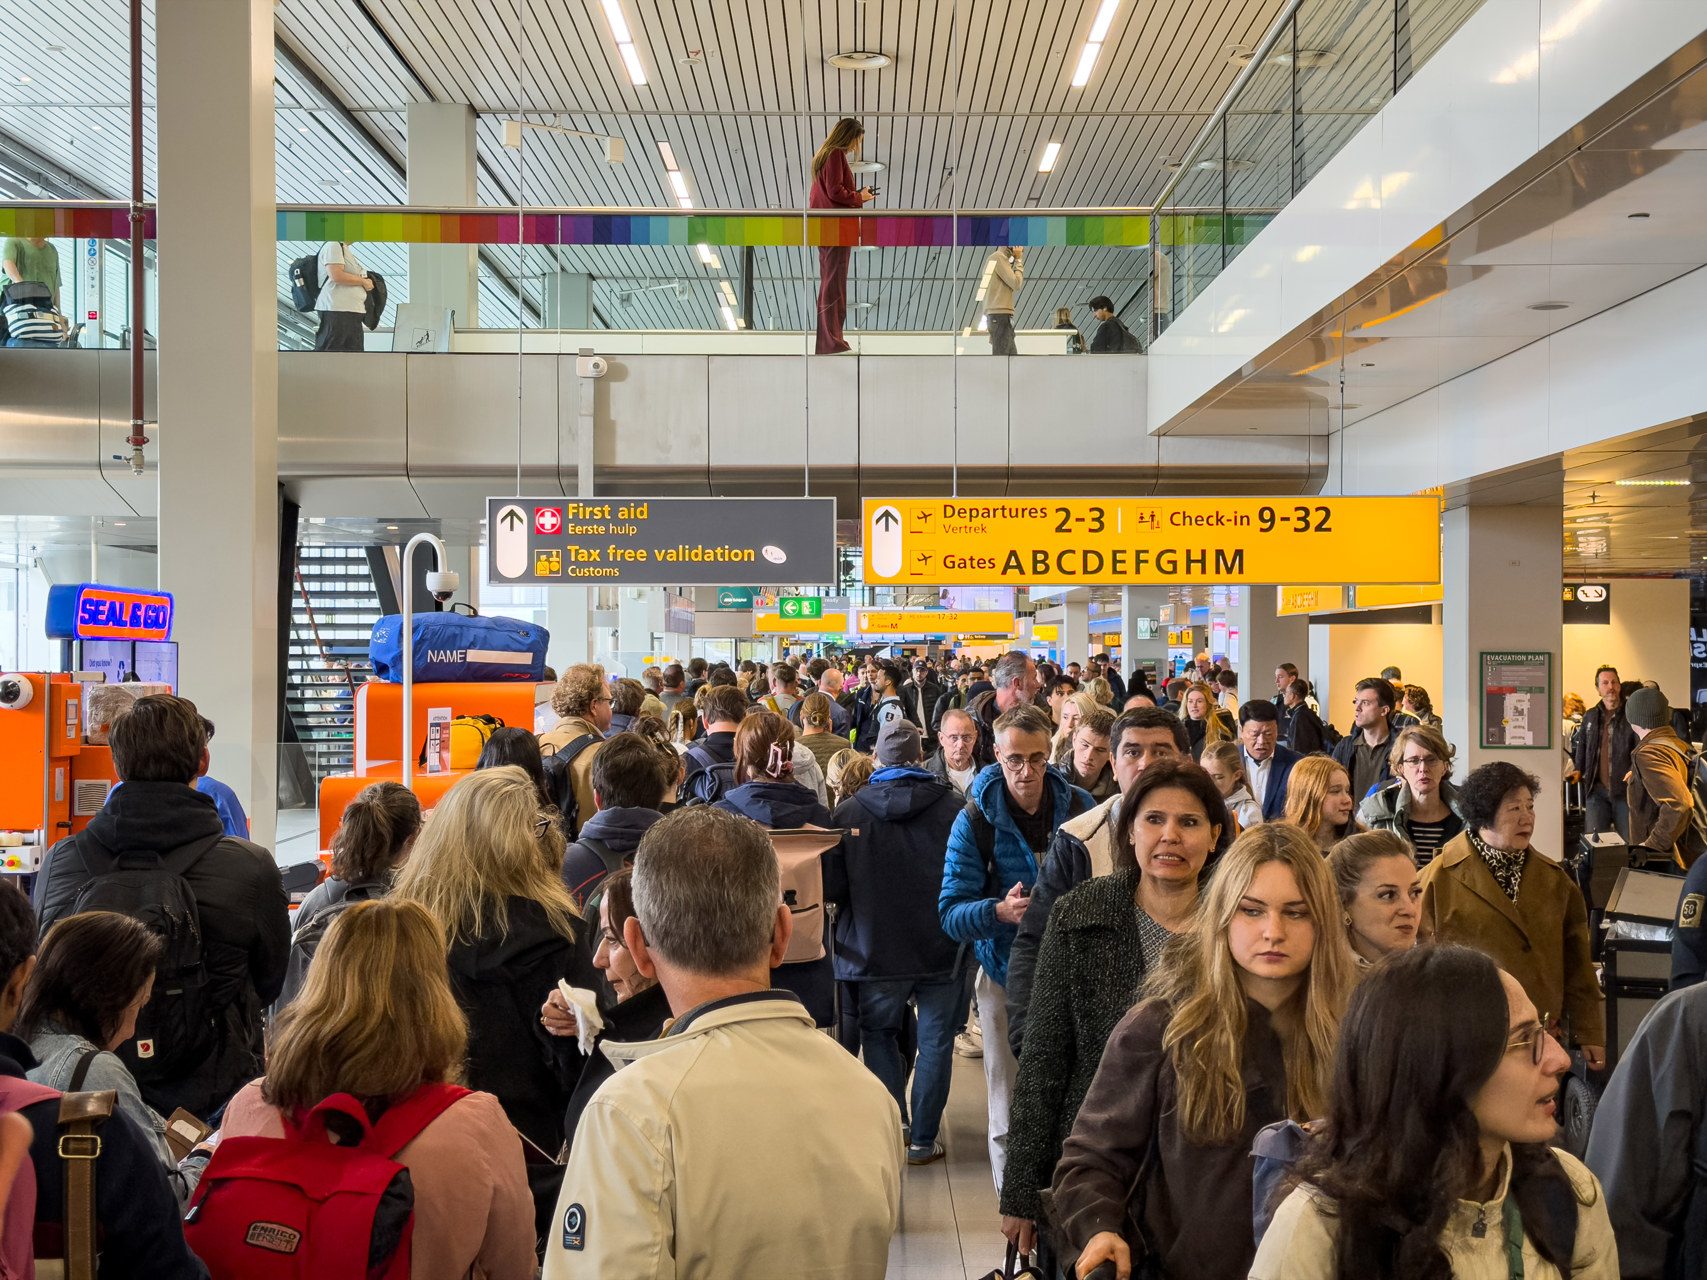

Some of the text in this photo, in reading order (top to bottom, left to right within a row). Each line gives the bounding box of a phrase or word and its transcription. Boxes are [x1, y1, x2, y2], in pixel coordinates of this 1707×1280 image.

[567, 503, 648, 520] First aid
[943, 504, 1333, 534] Departures 2-3 Check-in 9-32
[567, 523, 638, 536] Eerste hulp
[943, 524, 988, 534] Vertrek
[567, 545, 756, 562] Tax free validation
[943, 549, 1245, 576] Gates ABCDEFGHM
[567, 565, 620, 577] Customs
[427, 650, 466, 663] NAME
[252, 1224, 296, 1240] ENRICO
